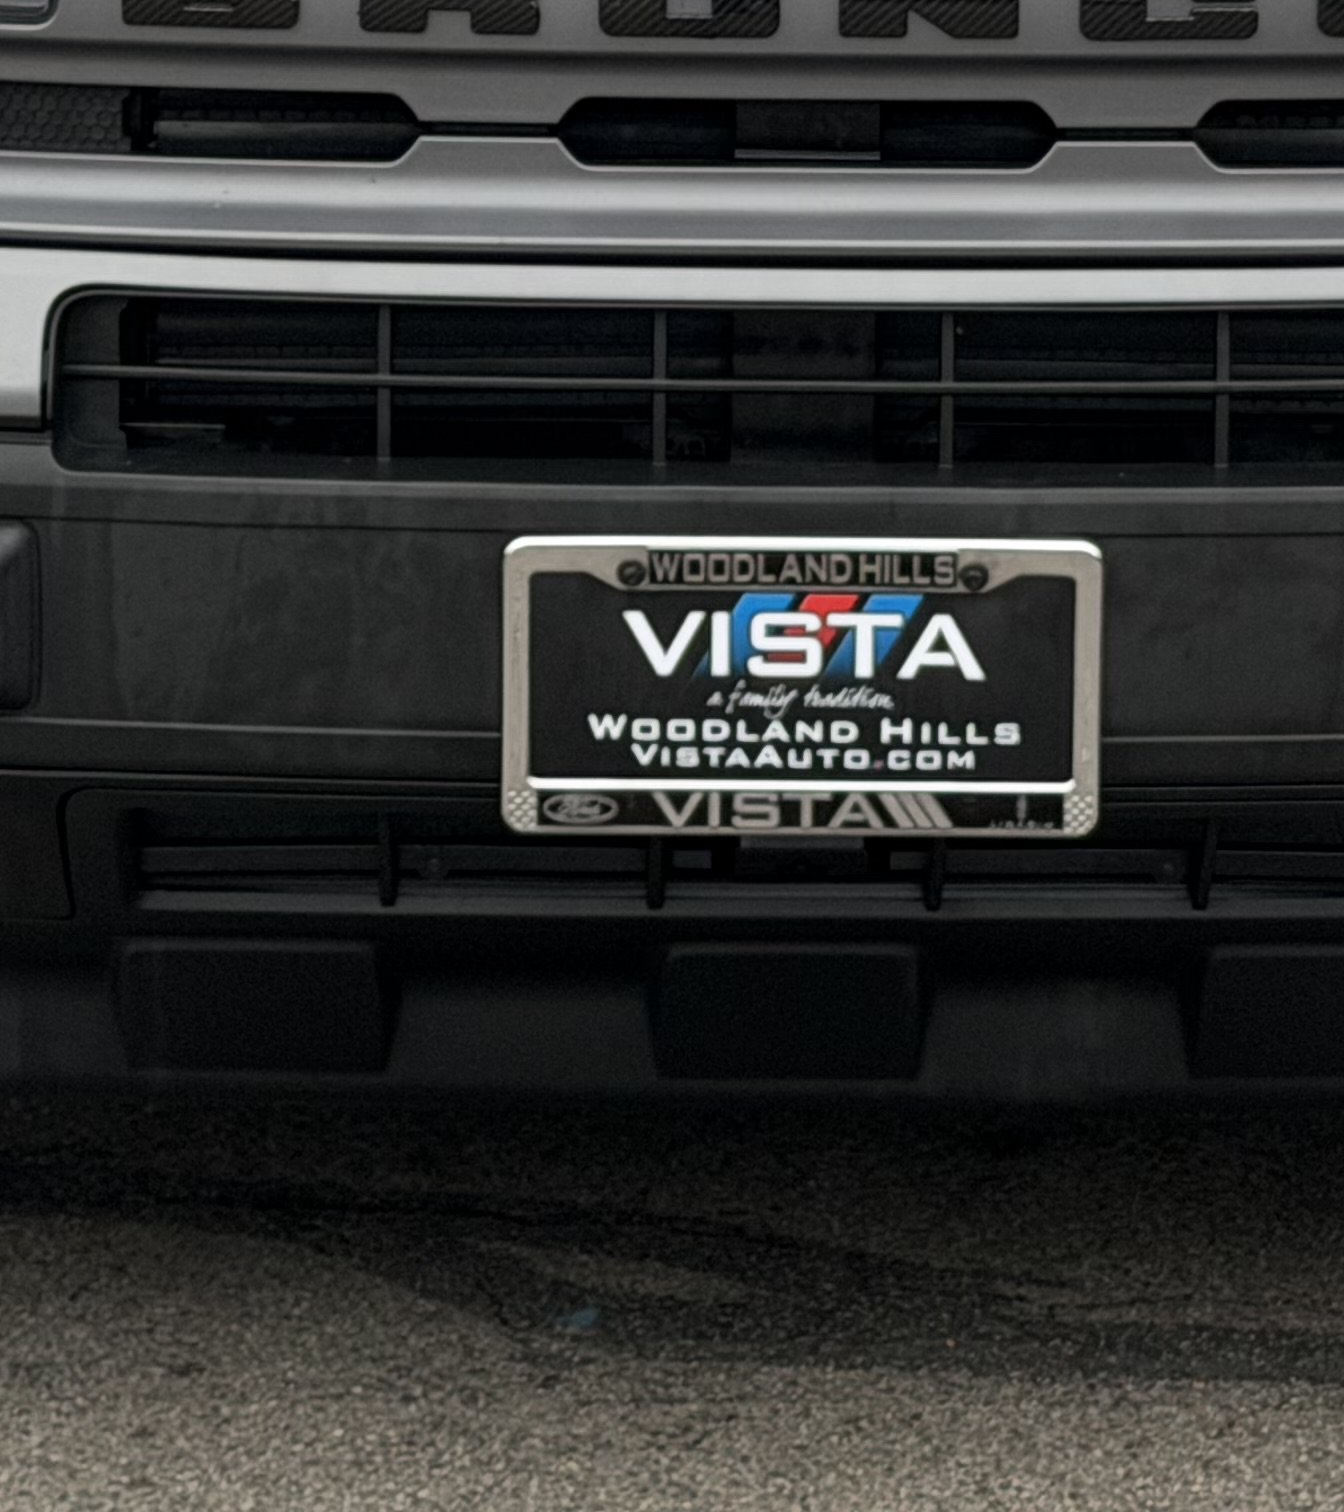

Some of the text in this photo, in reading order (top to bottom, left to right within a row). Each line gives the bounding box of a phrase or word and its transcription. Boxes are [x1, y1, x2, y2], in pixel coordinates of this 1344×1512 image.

[651, 552, 956, 586] WOODLAND HILLS
[622, 609, 986, 682] VISTA
[725, 679, 800, 719] family
[803, 683, 896, 710] tradition
[587, 712, 1022, 746] WOODLAND HILLS
[651, 791, 885, 829] VISTA
